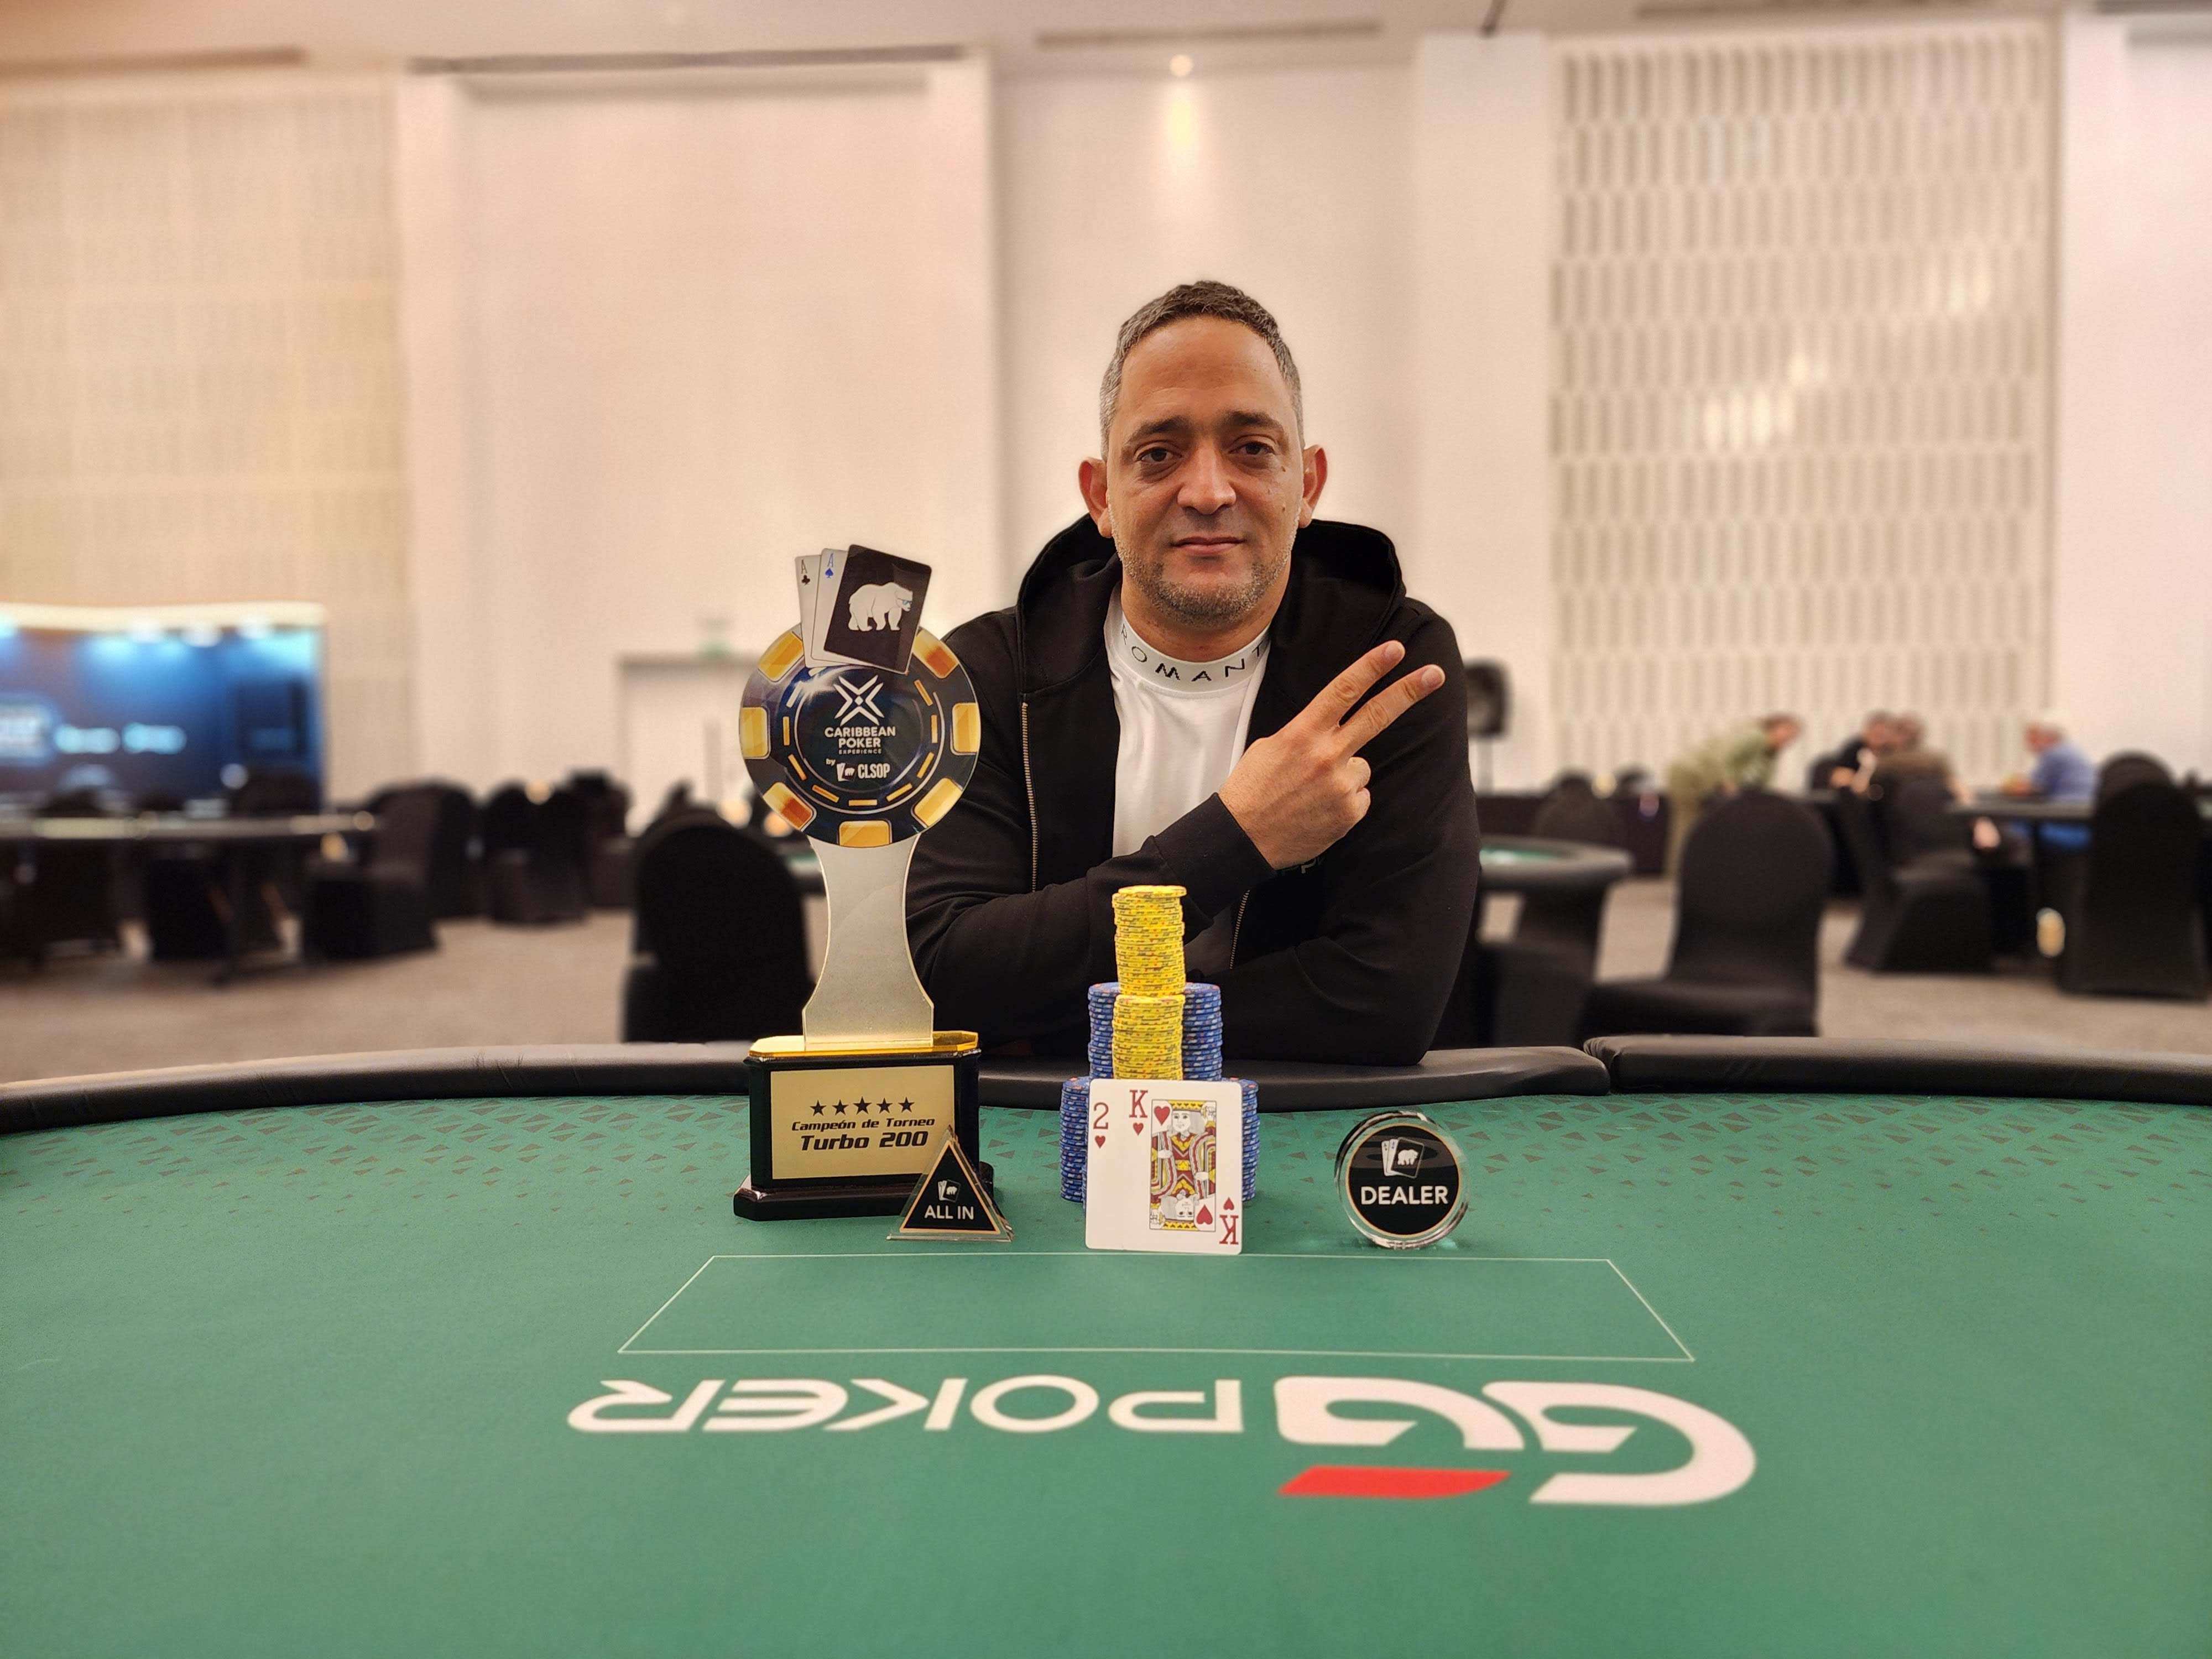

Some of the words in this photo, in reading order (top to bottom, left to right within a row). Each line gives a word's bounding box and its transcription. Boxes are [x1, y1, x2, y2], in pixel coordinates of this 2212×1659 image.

[801, 559, 807, 574] A
[827, 553, 833, 567] A
[825, 726, 896, 737] CARIBBEAN
[838, 737, 881, 748] POKER
[858, 763, 890, 779] CLSOP
[1129, 1089, 1148, 1118] K
[1093, 1102, 1108, 1129] 2
[792, 1120, 855, 1132] Campeón
[862, 1119, 879, 1128] de
[886, 1118, 935, 1127] Torneo
[801, 1134, 869, 1151] Turbo
[879, 1131, 928, 1147] 200
[1361, 1186, 1448, 1205] DEALER
[924, 1205, 953, 1219] ALL
[958, 1206, 974, 1220] IN
[1219, 1214, 1239, 1244] K
